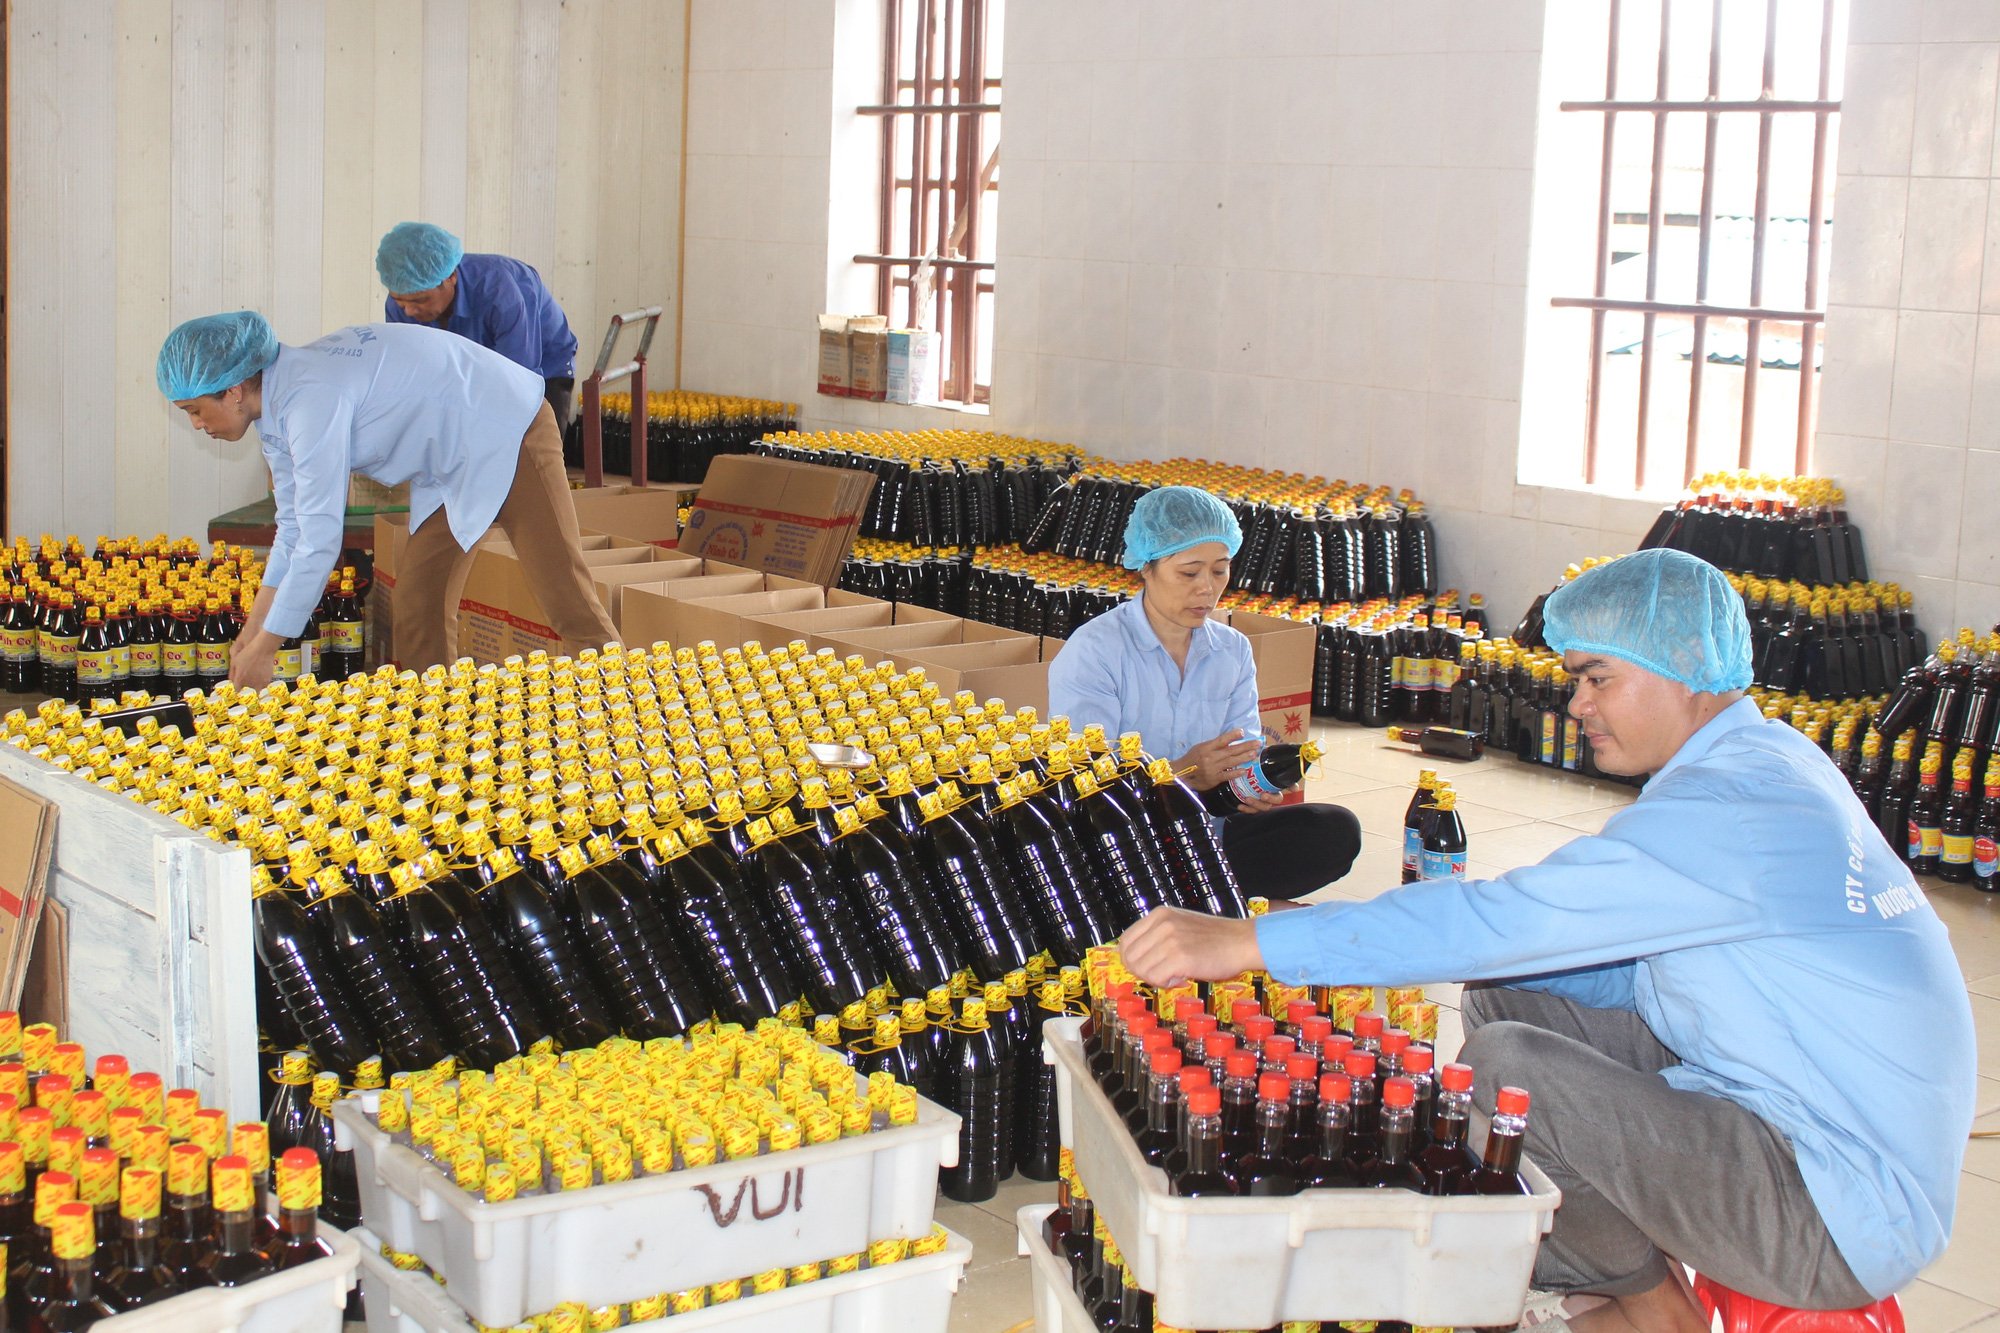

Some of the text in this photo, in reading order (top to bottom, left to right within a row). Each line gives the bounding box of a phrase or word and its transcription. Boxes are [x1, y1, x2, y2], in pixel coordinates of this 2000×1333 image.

[1246, 766, 1266, 794] Nin
[1845, 874, 1866, 913] CTY
[689, 1167, 804, 1228] VUI
